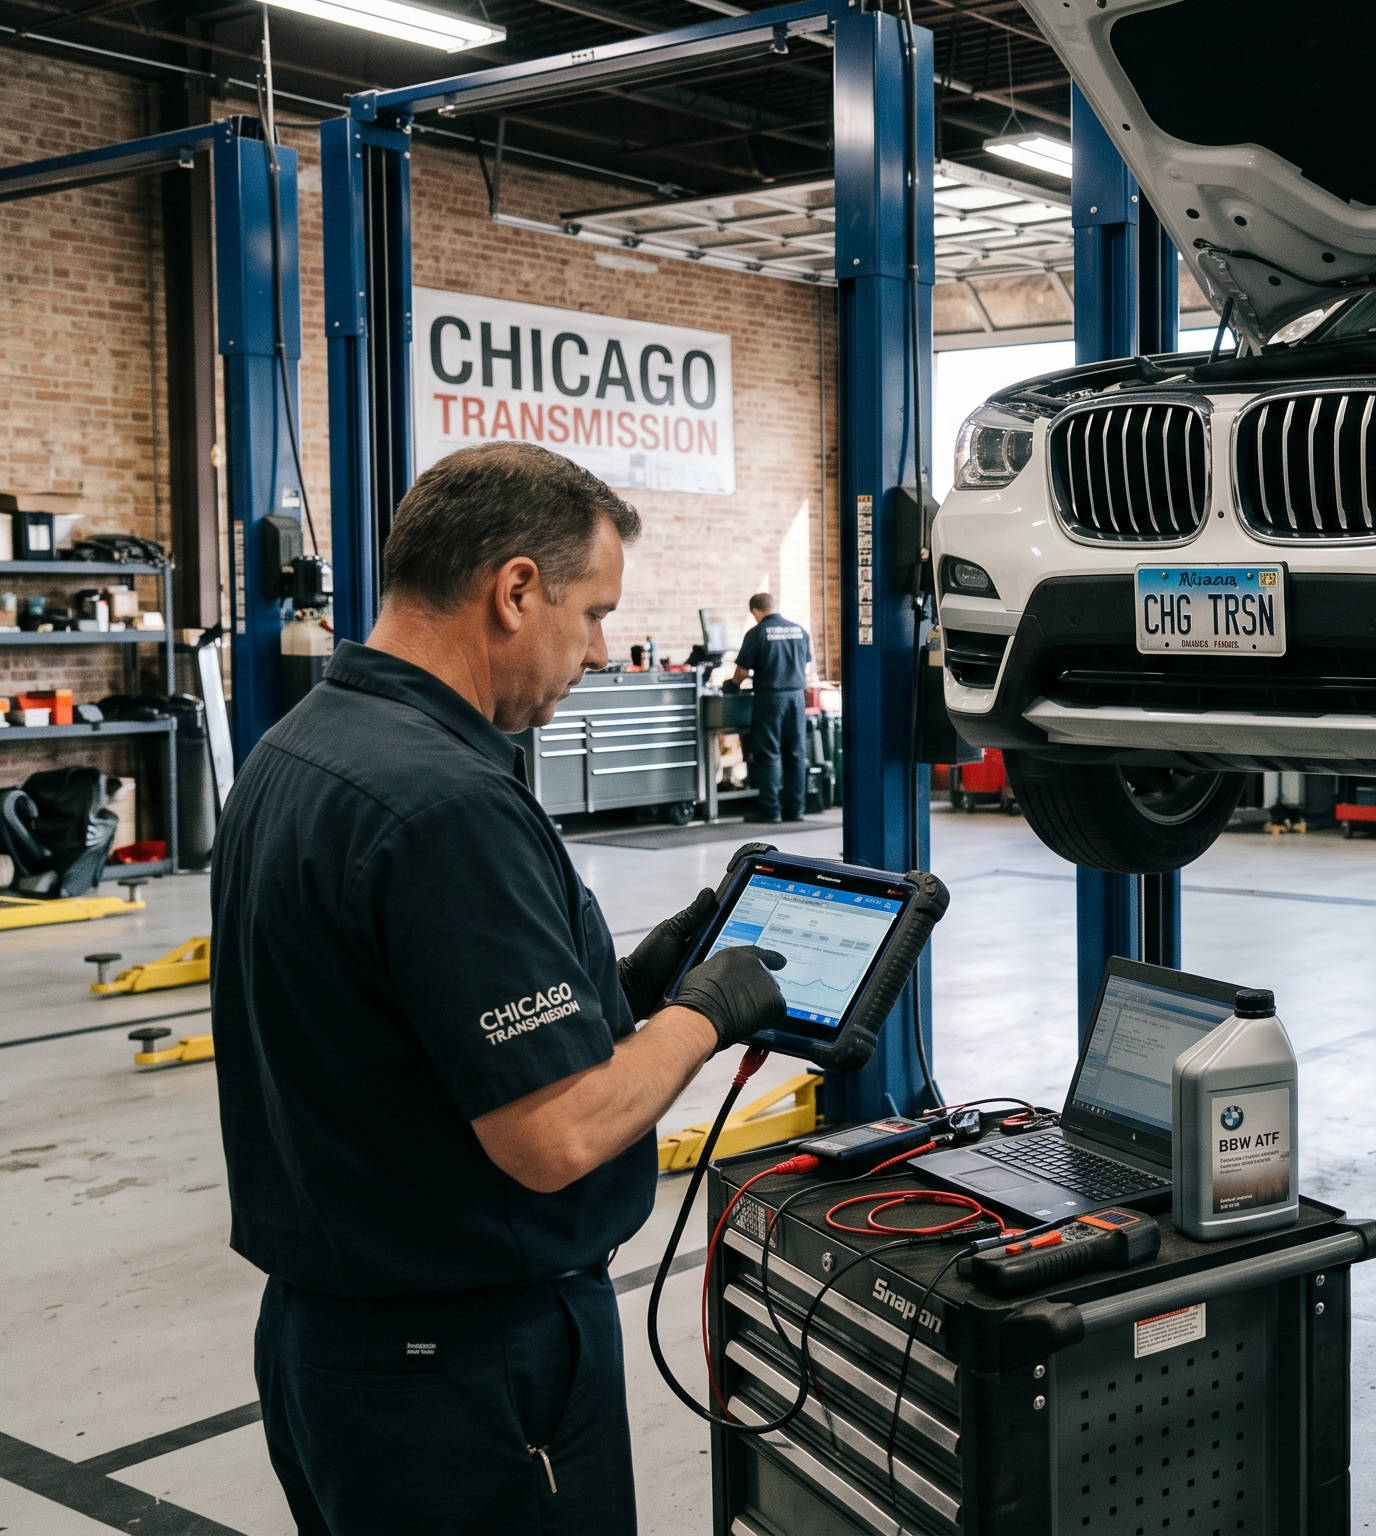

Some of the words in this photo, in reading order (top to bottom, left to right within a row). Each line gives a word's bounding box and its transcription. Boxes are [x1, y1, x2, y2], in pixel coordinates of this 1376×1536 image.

[429, 315, 716, 411] CHICAGO
[433, 393, 718, 456] TRANSMISSION
[1144, 593, 1192, 635] CHG
[1208, 593, 1275, 636] TRSN
[479, 982, 572, 1031] CHICAGO
[1219, 1136, 1252, 1153] BBW
[1254, 1131, 1280, 1148] ATF
[872, 1278, 942, 1334] Snapon
